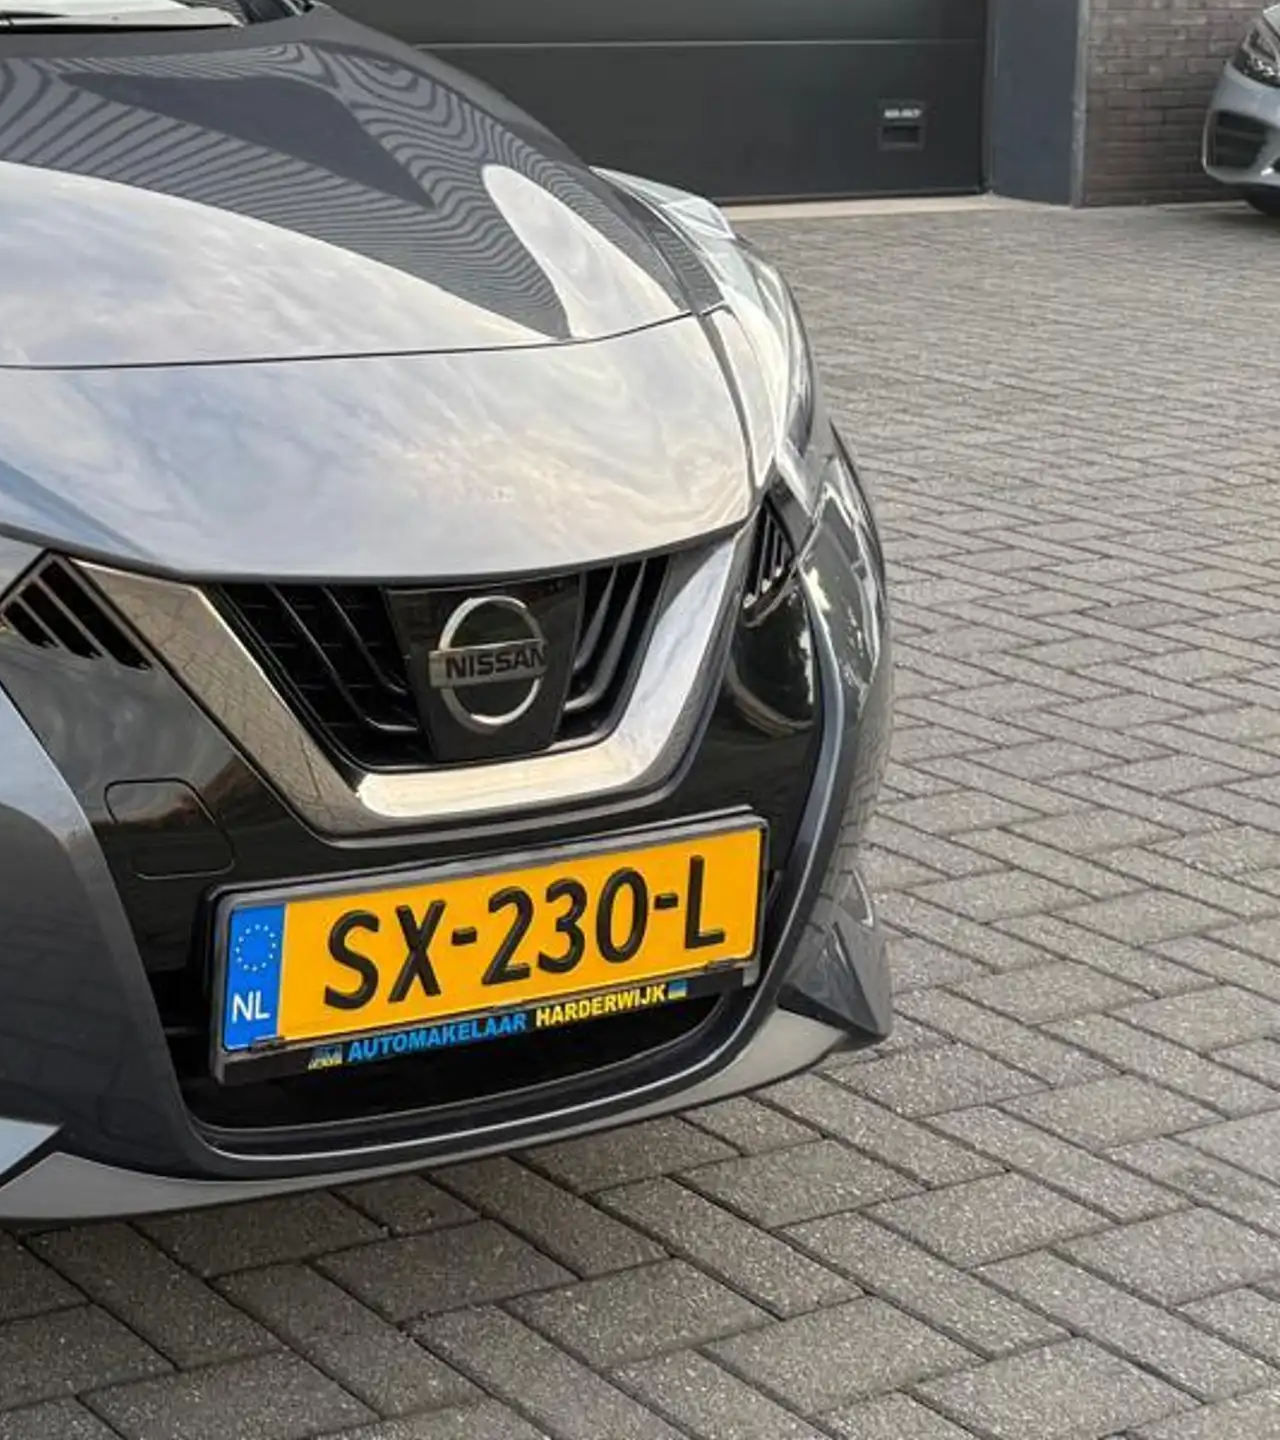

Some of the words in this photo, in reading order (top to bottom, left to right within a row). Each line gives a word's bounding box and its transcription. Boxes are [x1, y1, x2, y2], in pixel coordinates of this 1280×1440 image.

[444, 645, 547, 680] NISSAN
[322, 854, 726, 1011] SX-230-L
[231, 991, 270, 1024] NL
[348, 1013, 528, 1063] AUTOMAKELAAR
[535, 982, 666, 1028] HARDERWIJK
